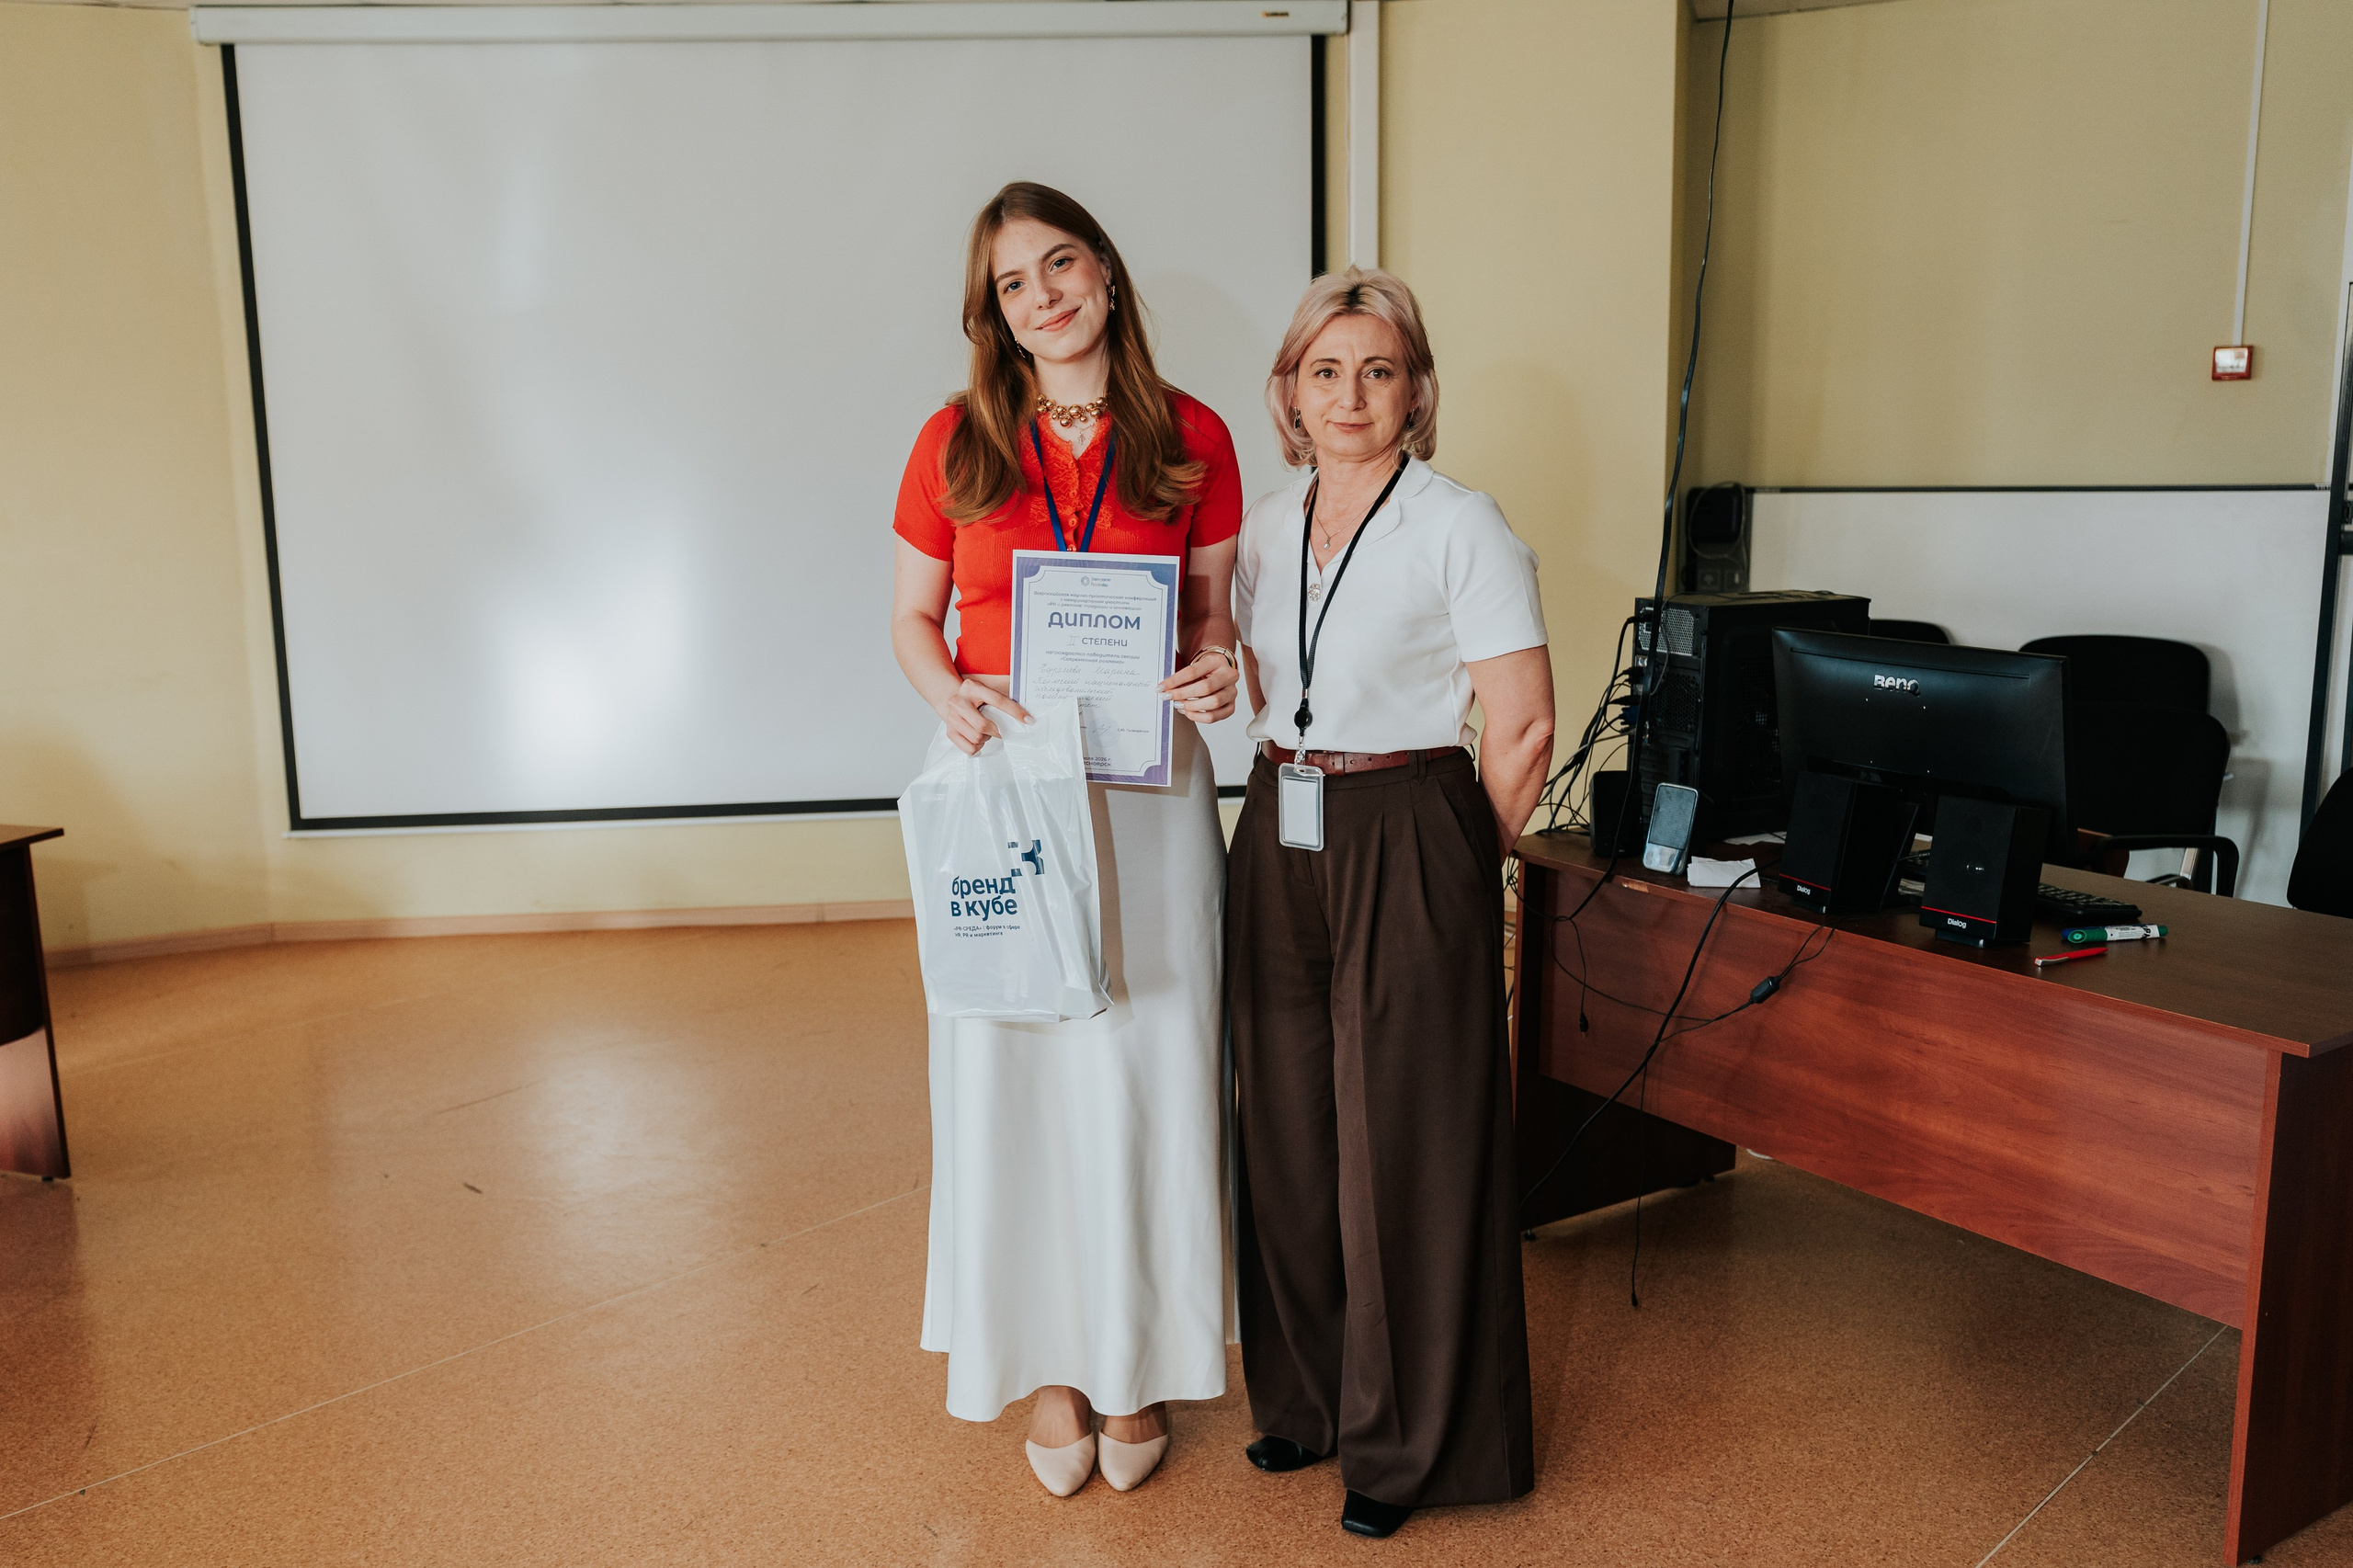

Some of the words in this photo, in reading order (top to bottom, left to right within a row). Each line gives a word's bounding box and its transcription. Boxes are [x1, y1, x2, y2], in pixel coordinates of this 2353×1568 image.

[1048, 611, 1141, 631] ДИПЛОМ
[1082, 637, 1128, 647] СТЕПЕНИ
[1874, 675, 1921, 697] BenQ
[951, 875, 1017, 899] бренд
[1796, 884, 1811, 895] Dialog
[950, 901, 961, 917] в
[965, 895, 1017, 921] кубе
[1947, 918, 1967, 929] Dialog
